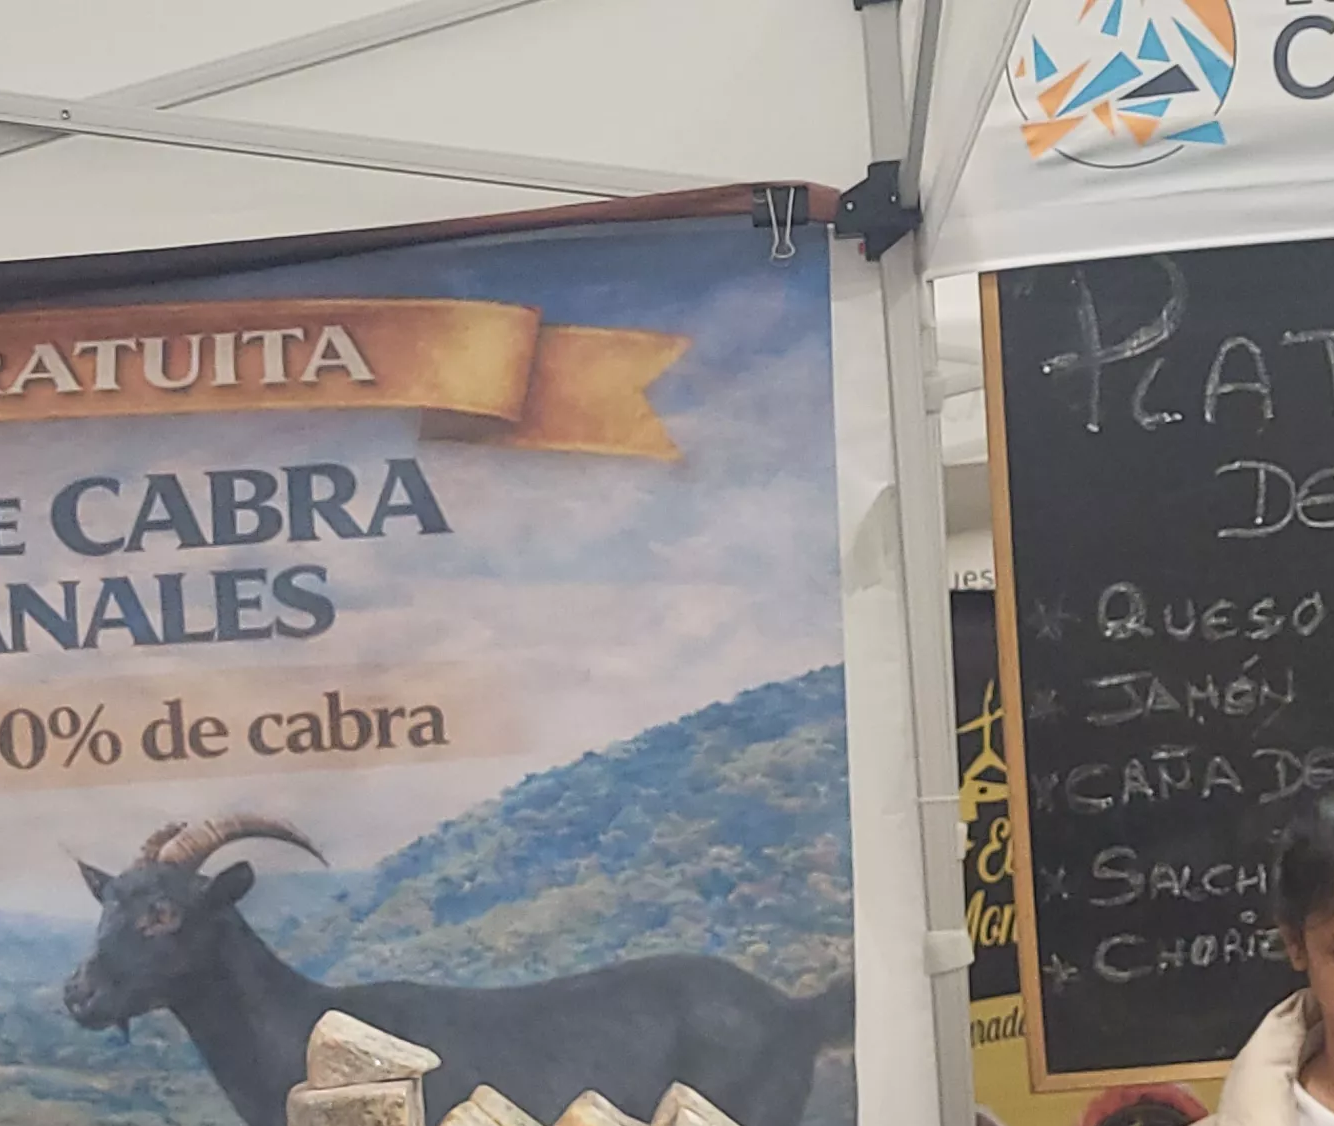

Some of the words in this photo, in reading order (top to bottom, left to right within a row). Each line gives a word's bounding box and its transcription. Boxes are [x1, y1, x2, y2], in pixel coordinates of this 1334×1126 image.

[50, 457, 454, 560] CABRA
[1098, 582, 1326, 641] QUESO
[143, 698, 229, 761] de
[247, 690, 449, 758] cabra
[1085, 656, 1298, 727] JAMÓN
[1066, 744, 1243, 814] CAÑA
